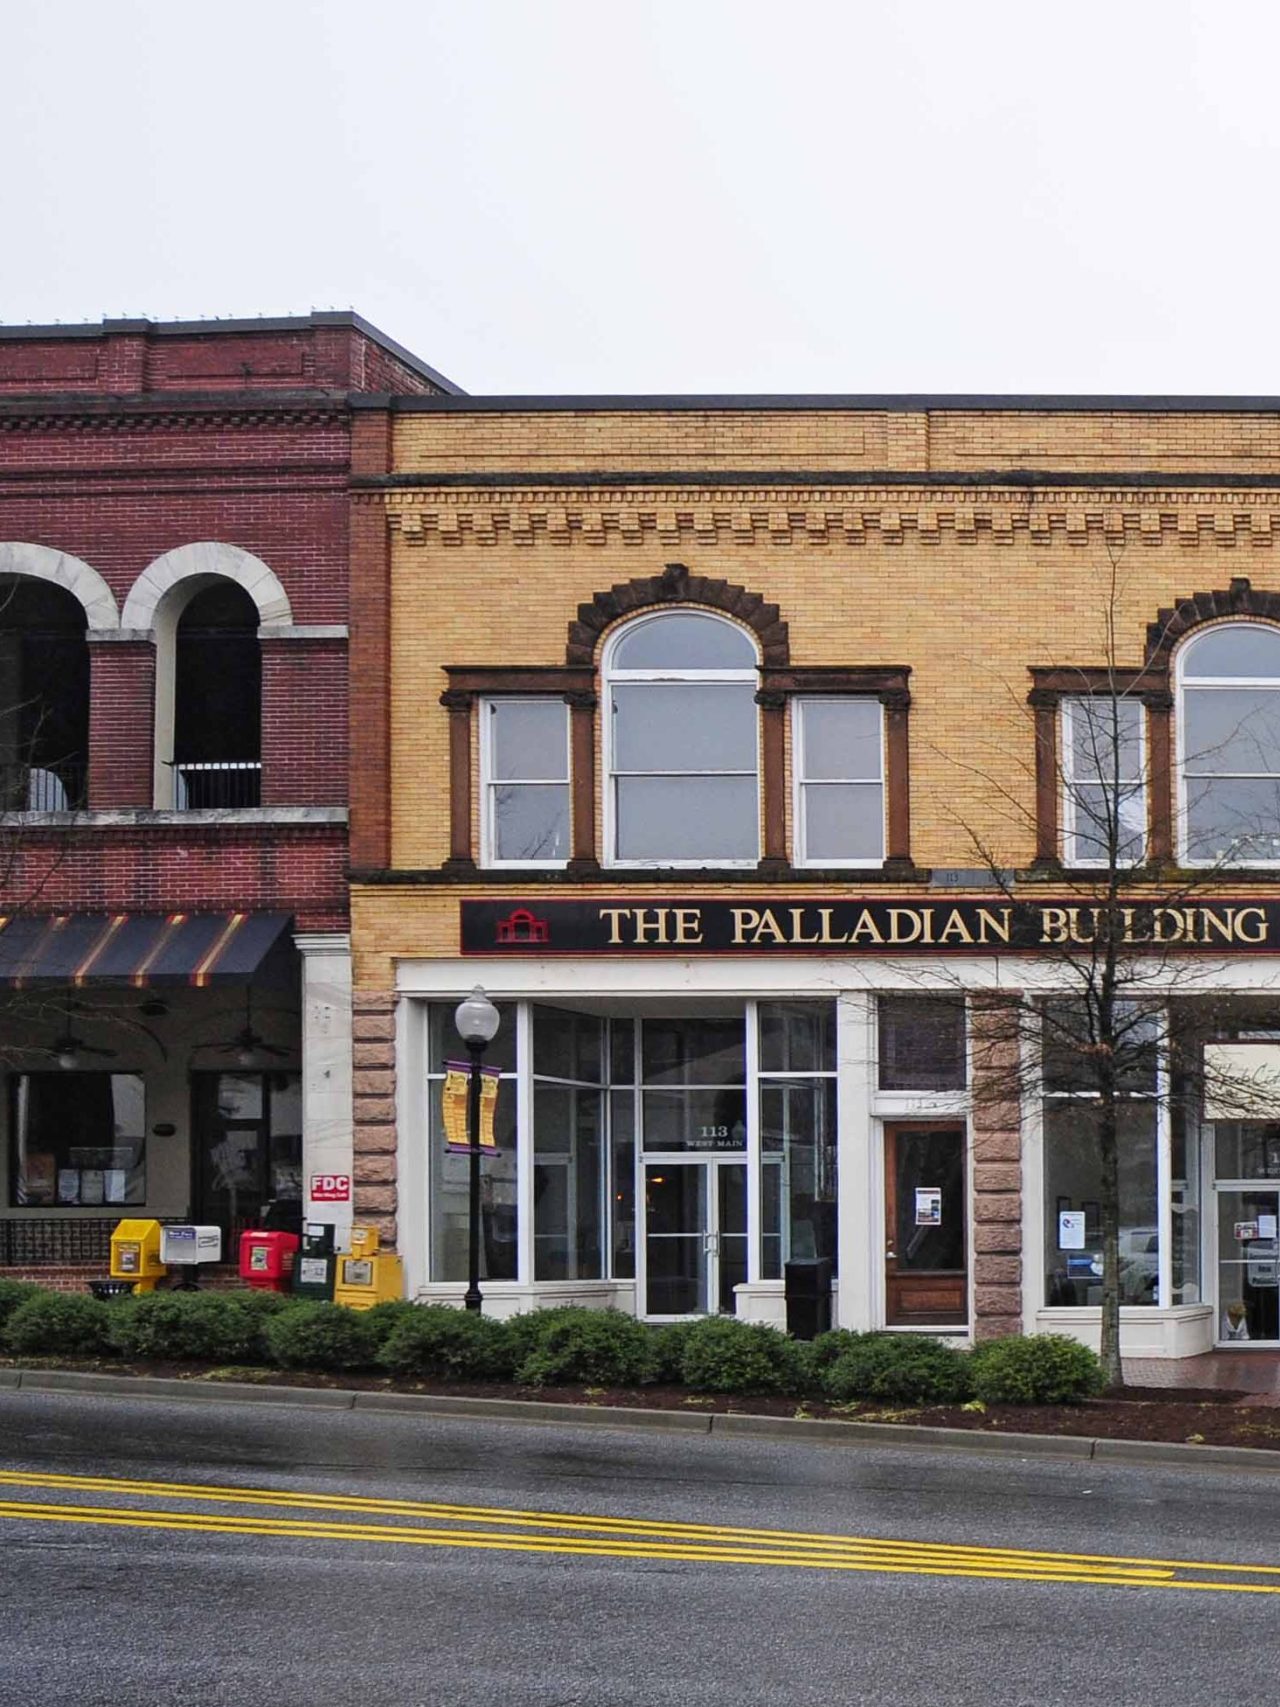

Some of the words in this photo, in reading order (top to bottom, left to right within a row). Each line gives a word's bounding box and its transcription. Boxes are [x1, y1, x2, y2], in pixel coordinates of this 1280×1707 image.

[599, 908, 703, 943] THE
[729, 908, 1013, 943] PALLADIAN
[1038, 907, 1270, 943] BULDING
[702, 1125, 728, 1138] 113
[311, 1176, 349, 1191] FDC
